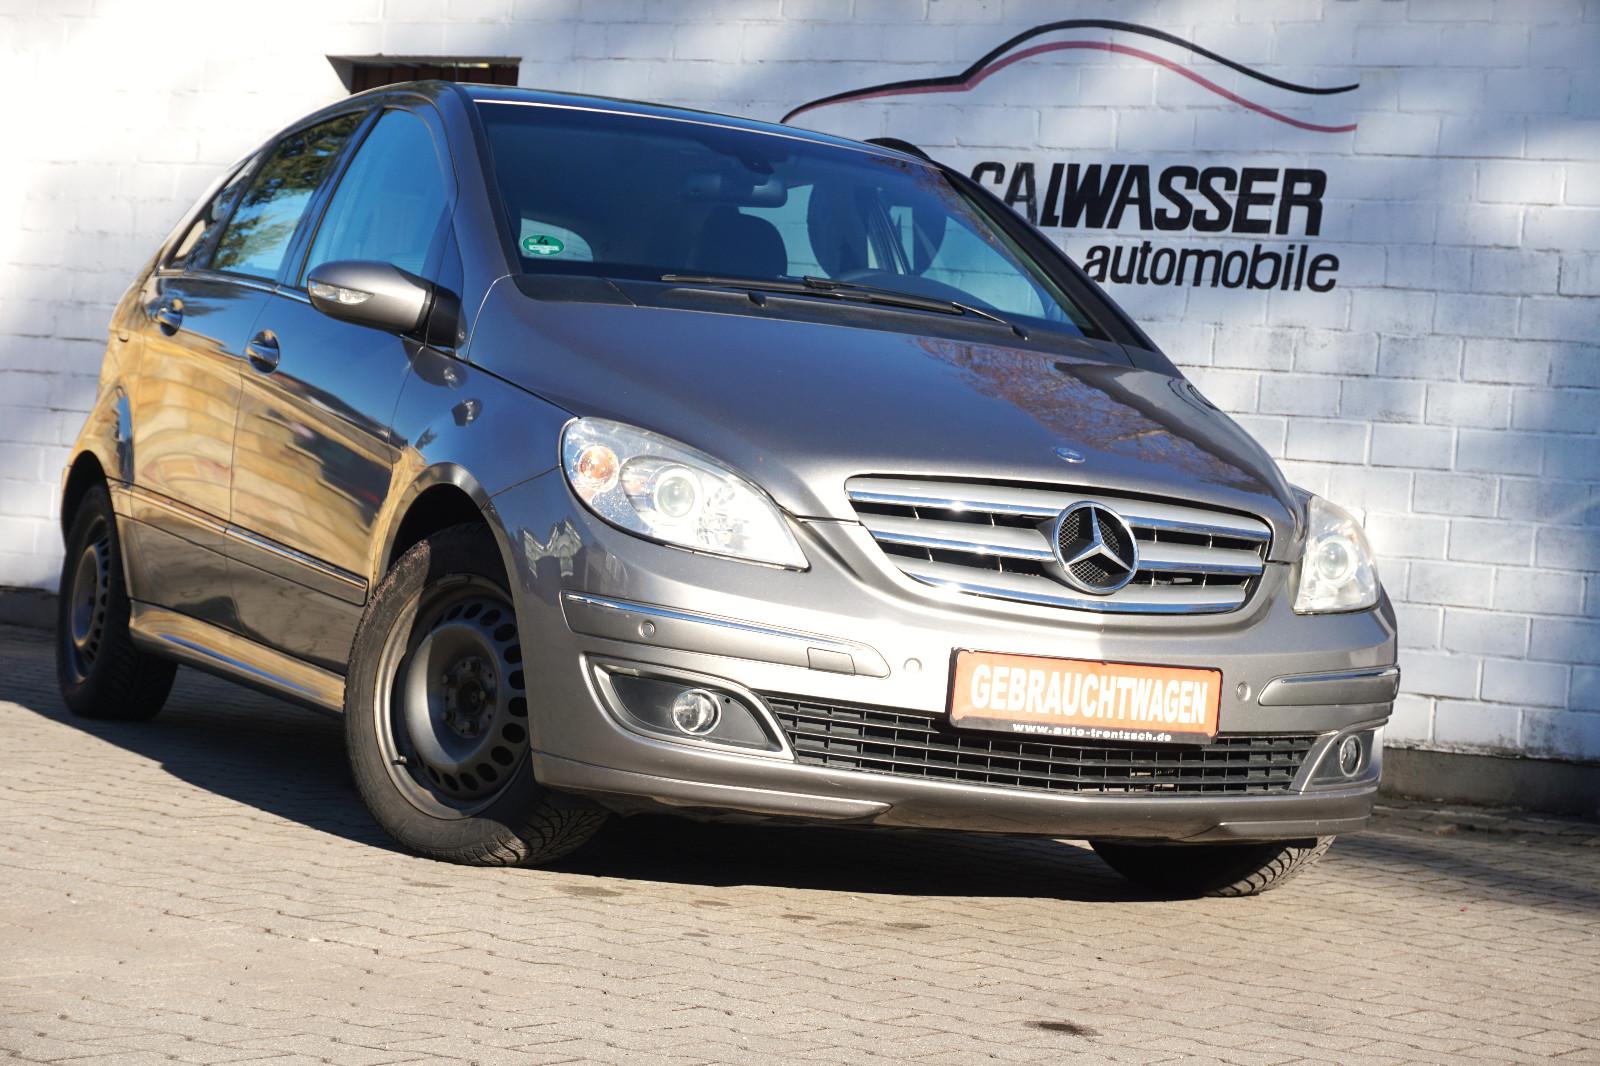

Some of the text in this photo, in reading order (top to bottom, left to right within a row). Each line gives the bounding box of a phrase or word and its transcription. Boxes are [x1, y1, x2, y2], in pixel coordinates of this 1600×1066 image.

[537, 235, 549, 245] 4
[1083, 240, 1340, 293] automobile
[970, 664, 1208, 724] GEBRAUCHTWAGEN
